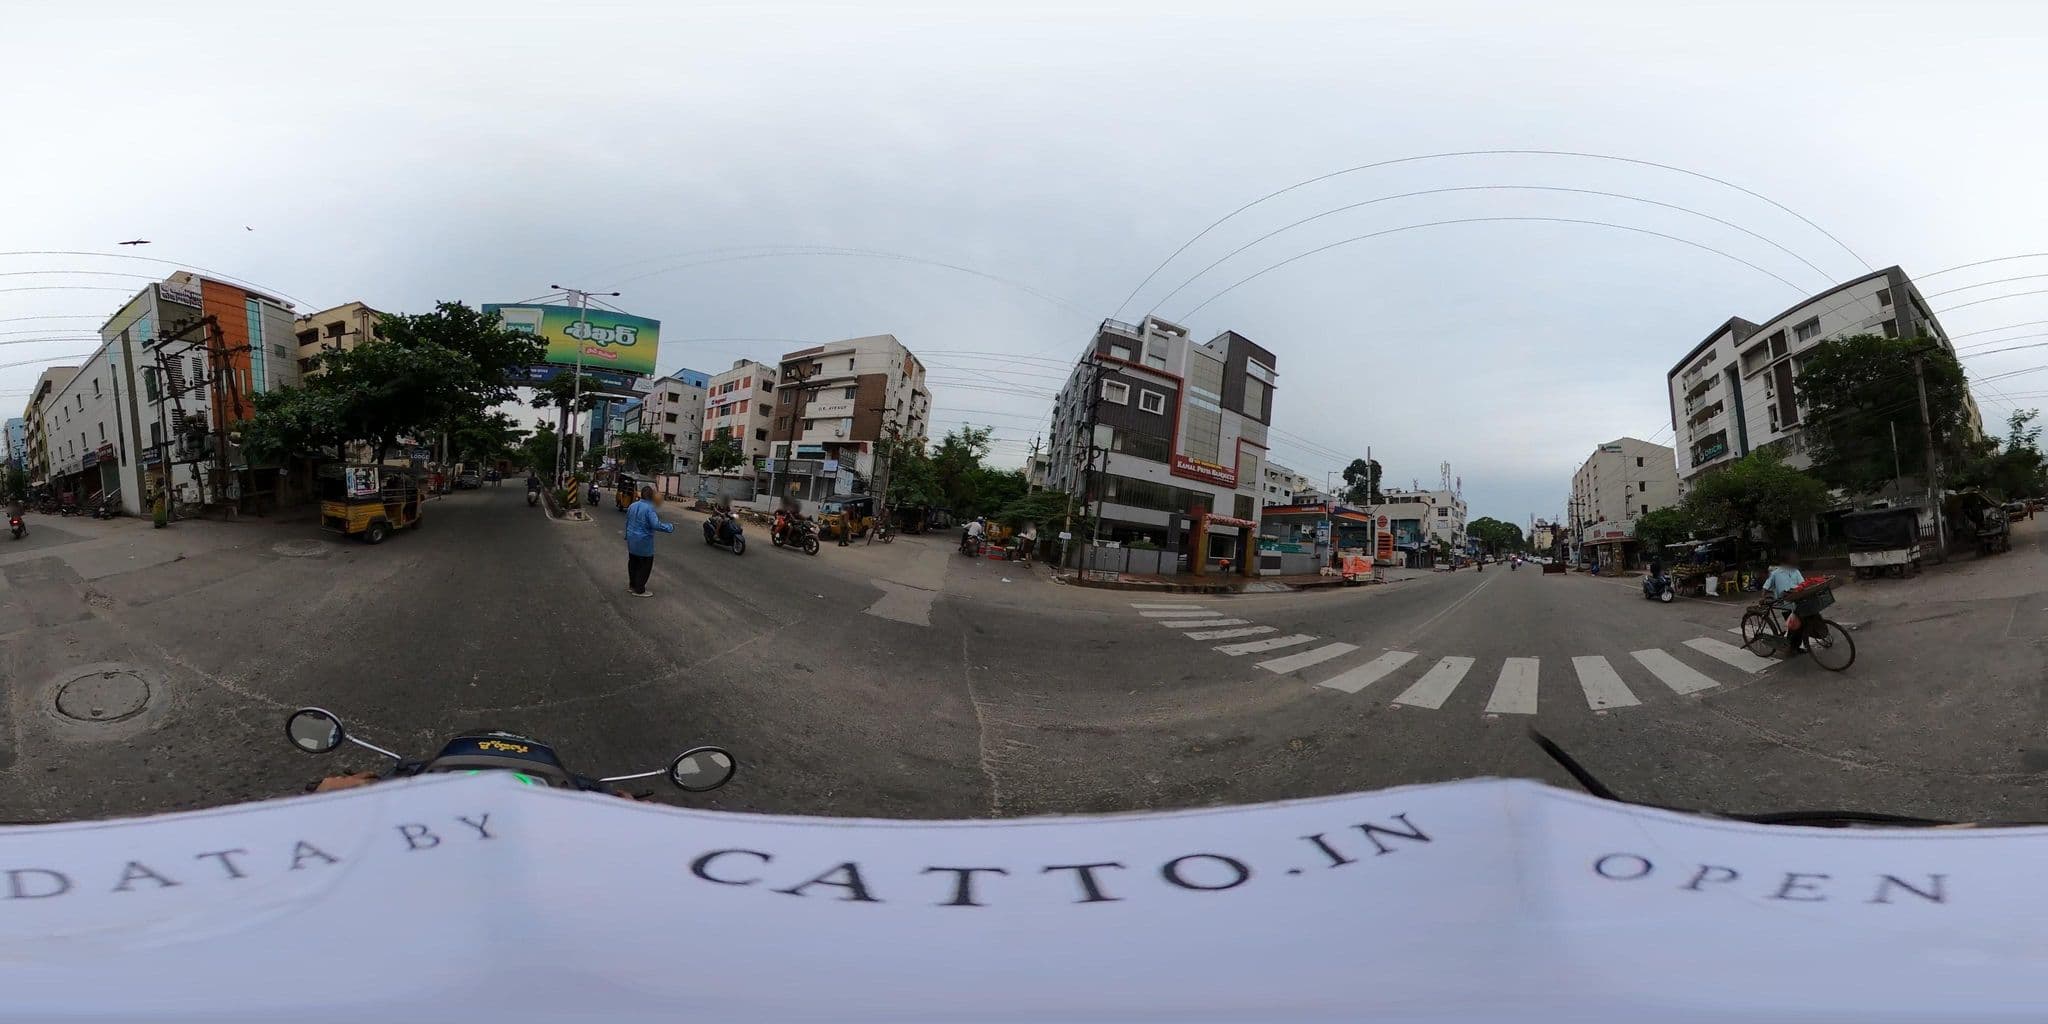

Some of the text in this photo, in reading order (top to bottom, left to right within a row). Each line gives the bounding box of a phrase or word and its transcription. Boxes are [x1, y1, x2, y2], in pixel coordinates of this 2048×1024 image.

[4, 812, 494, 901] DATA BY
[689, 812, 1434, 904] CATTO.IN
[1592, 852, 1948, 905] OPEN
